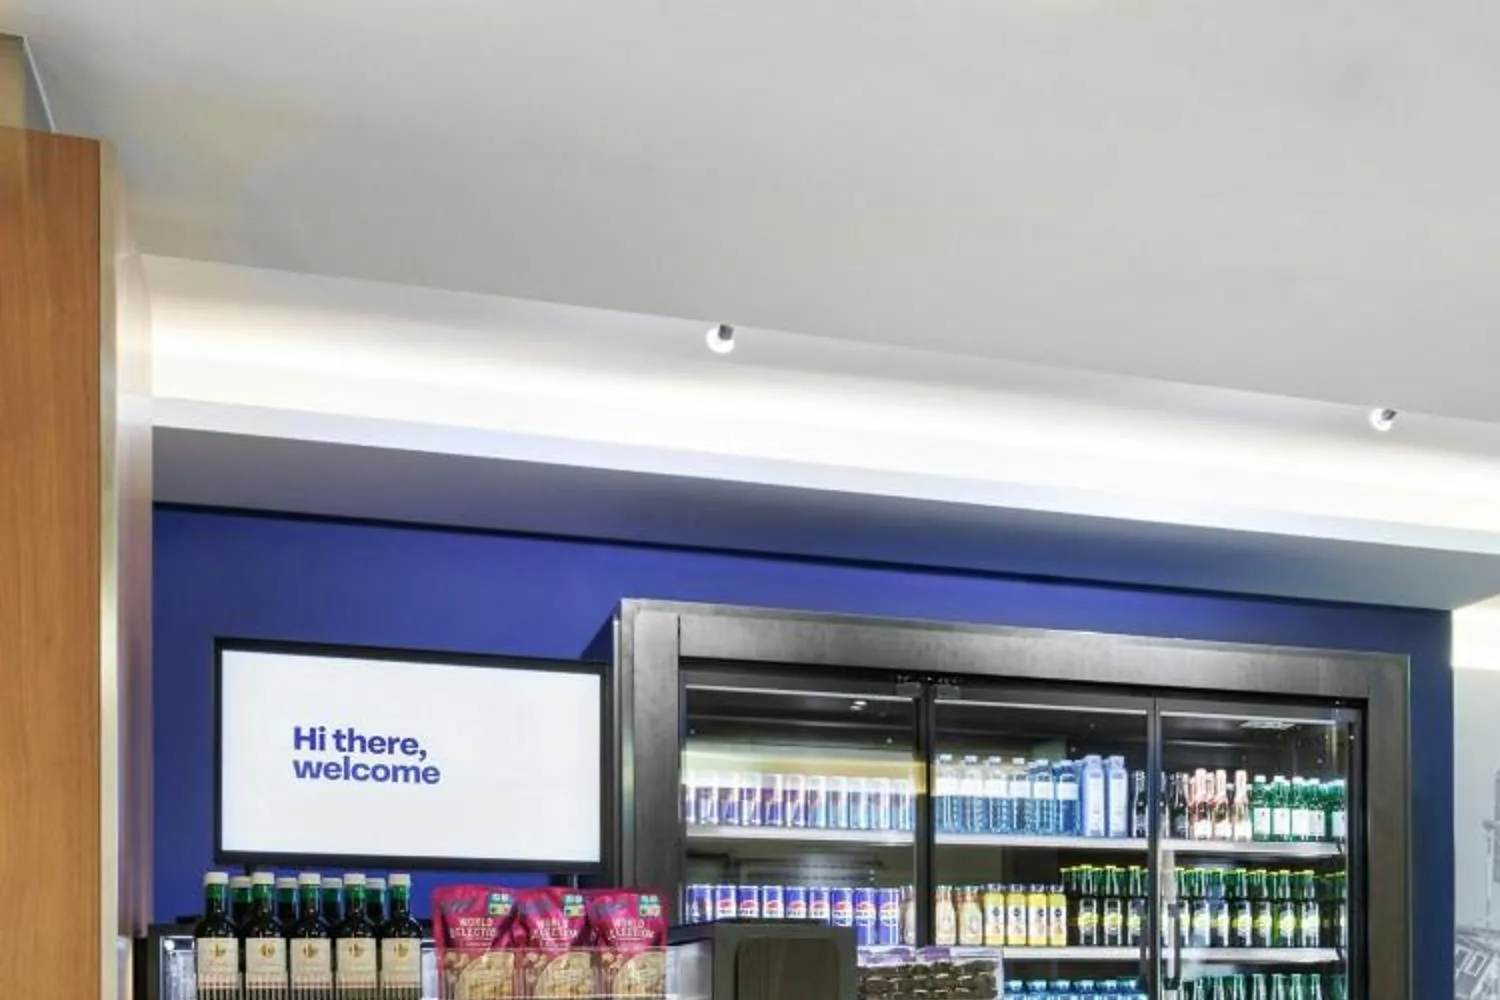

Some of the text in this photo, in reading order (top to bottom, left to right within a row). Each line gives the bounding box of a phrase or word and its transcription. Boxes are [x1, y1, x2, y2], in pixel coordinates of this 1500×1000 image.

[293, 725, 428, 762] Hi there,
[292, 755, 441, 785] welcome
